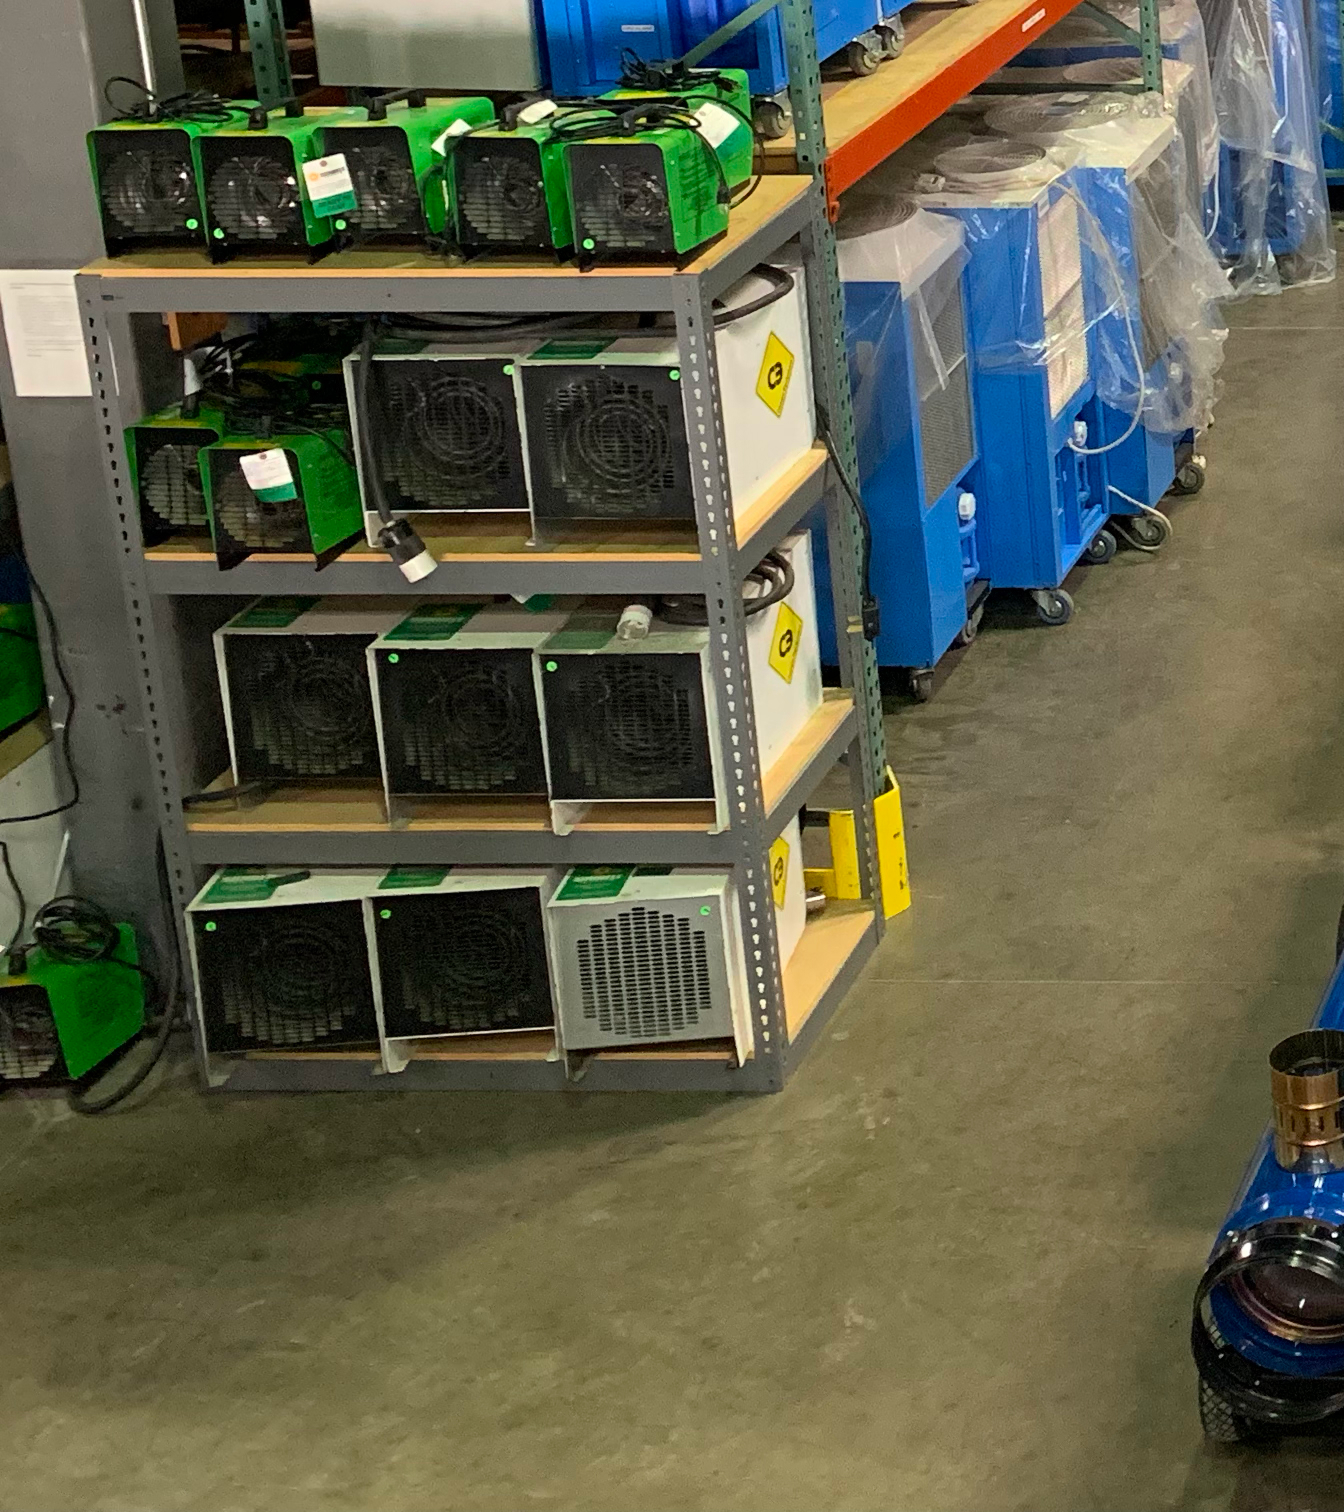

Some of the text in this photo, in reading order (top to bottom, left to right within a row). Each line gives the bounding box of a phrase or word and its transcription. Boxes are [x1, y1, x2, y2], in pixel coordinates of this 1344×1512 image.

[767, 361, 783, 390] C3
[779, 628, 793, 657] C3
[774, 856, 784, 886] C3
